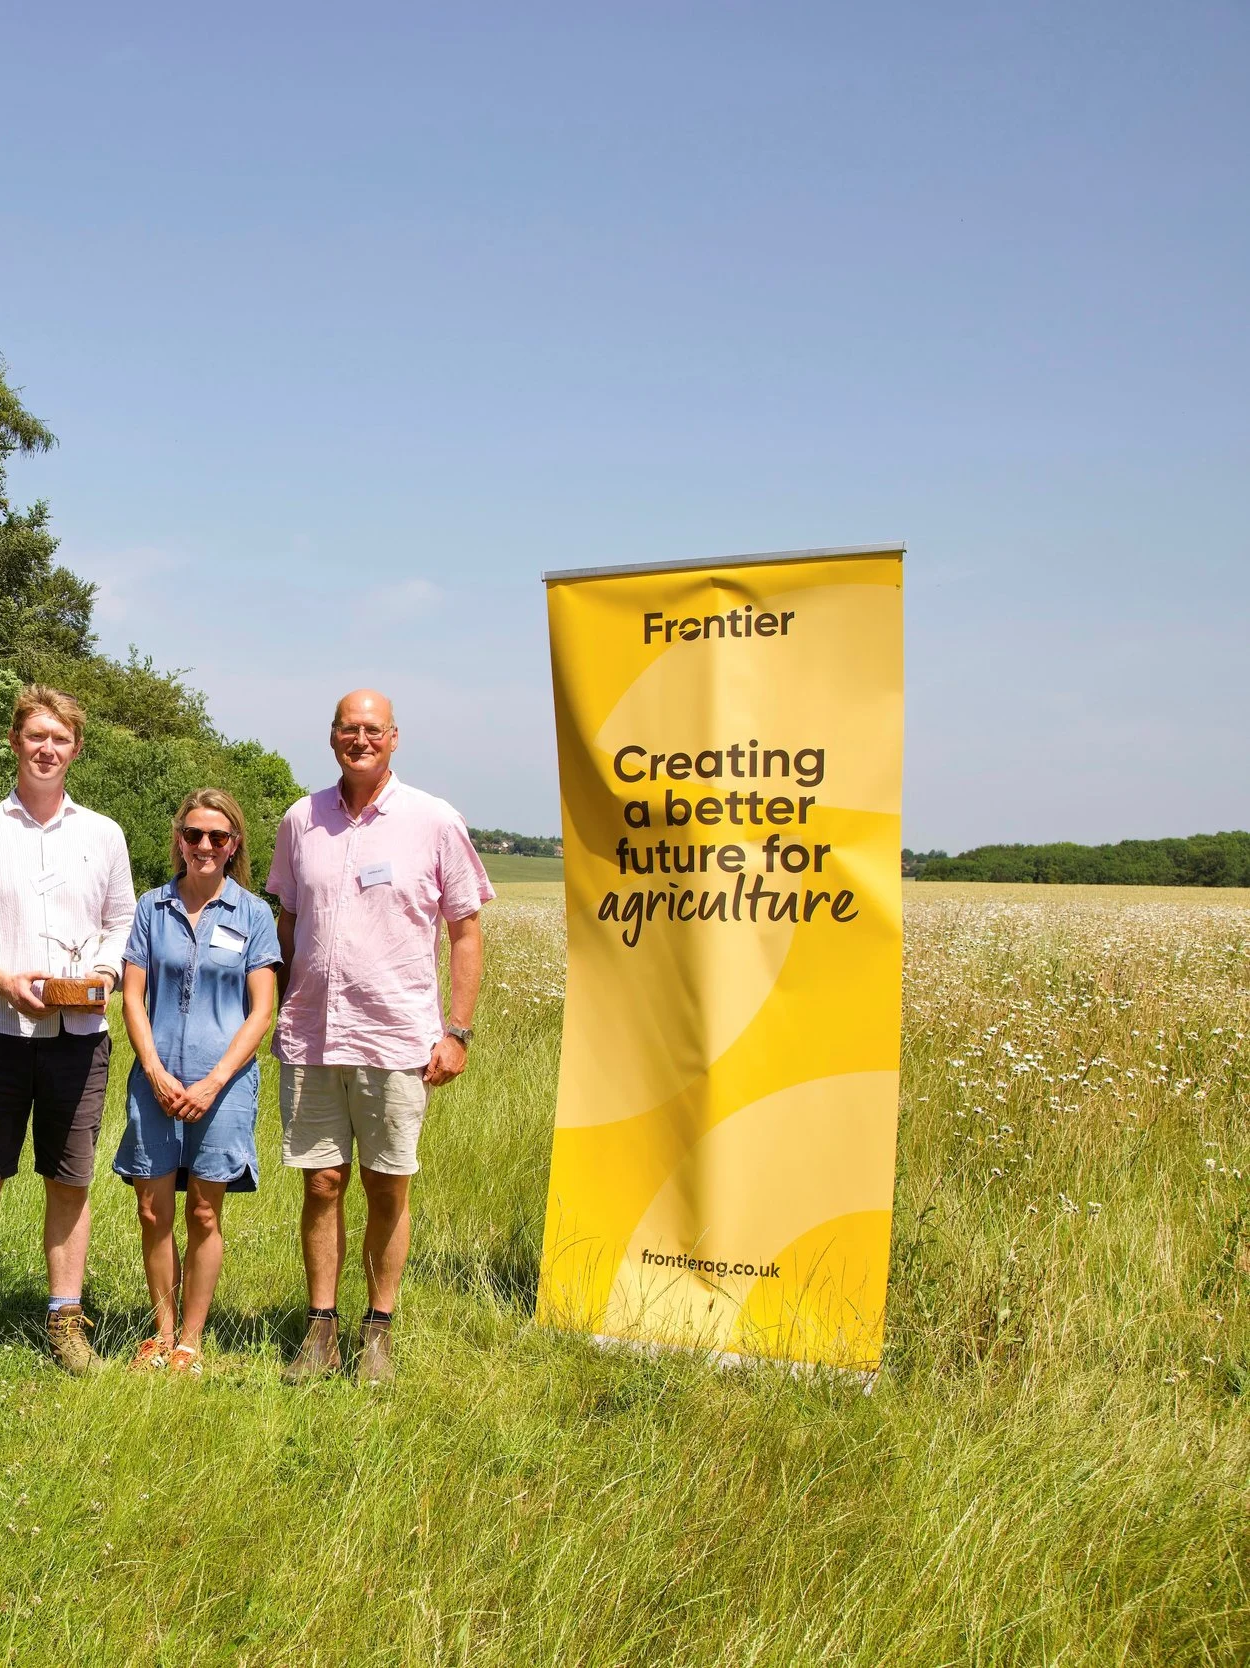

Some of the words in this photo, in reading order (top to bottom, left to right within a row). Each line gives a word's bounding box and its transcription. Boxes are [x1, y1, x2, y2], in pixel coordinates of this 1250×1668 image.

[643, 604, 795, 644] Frontier
[613, 738, 825, 788] Creating
[623, 799, 651, 829] a
[666, 789, 816, 827] better
[615, 836, 746, 875] future
[762, 833, 831, 874] for
[598, 871, 859, 948] agriculture
[641, 1248, 781, 1279] frontierag.co.uk
